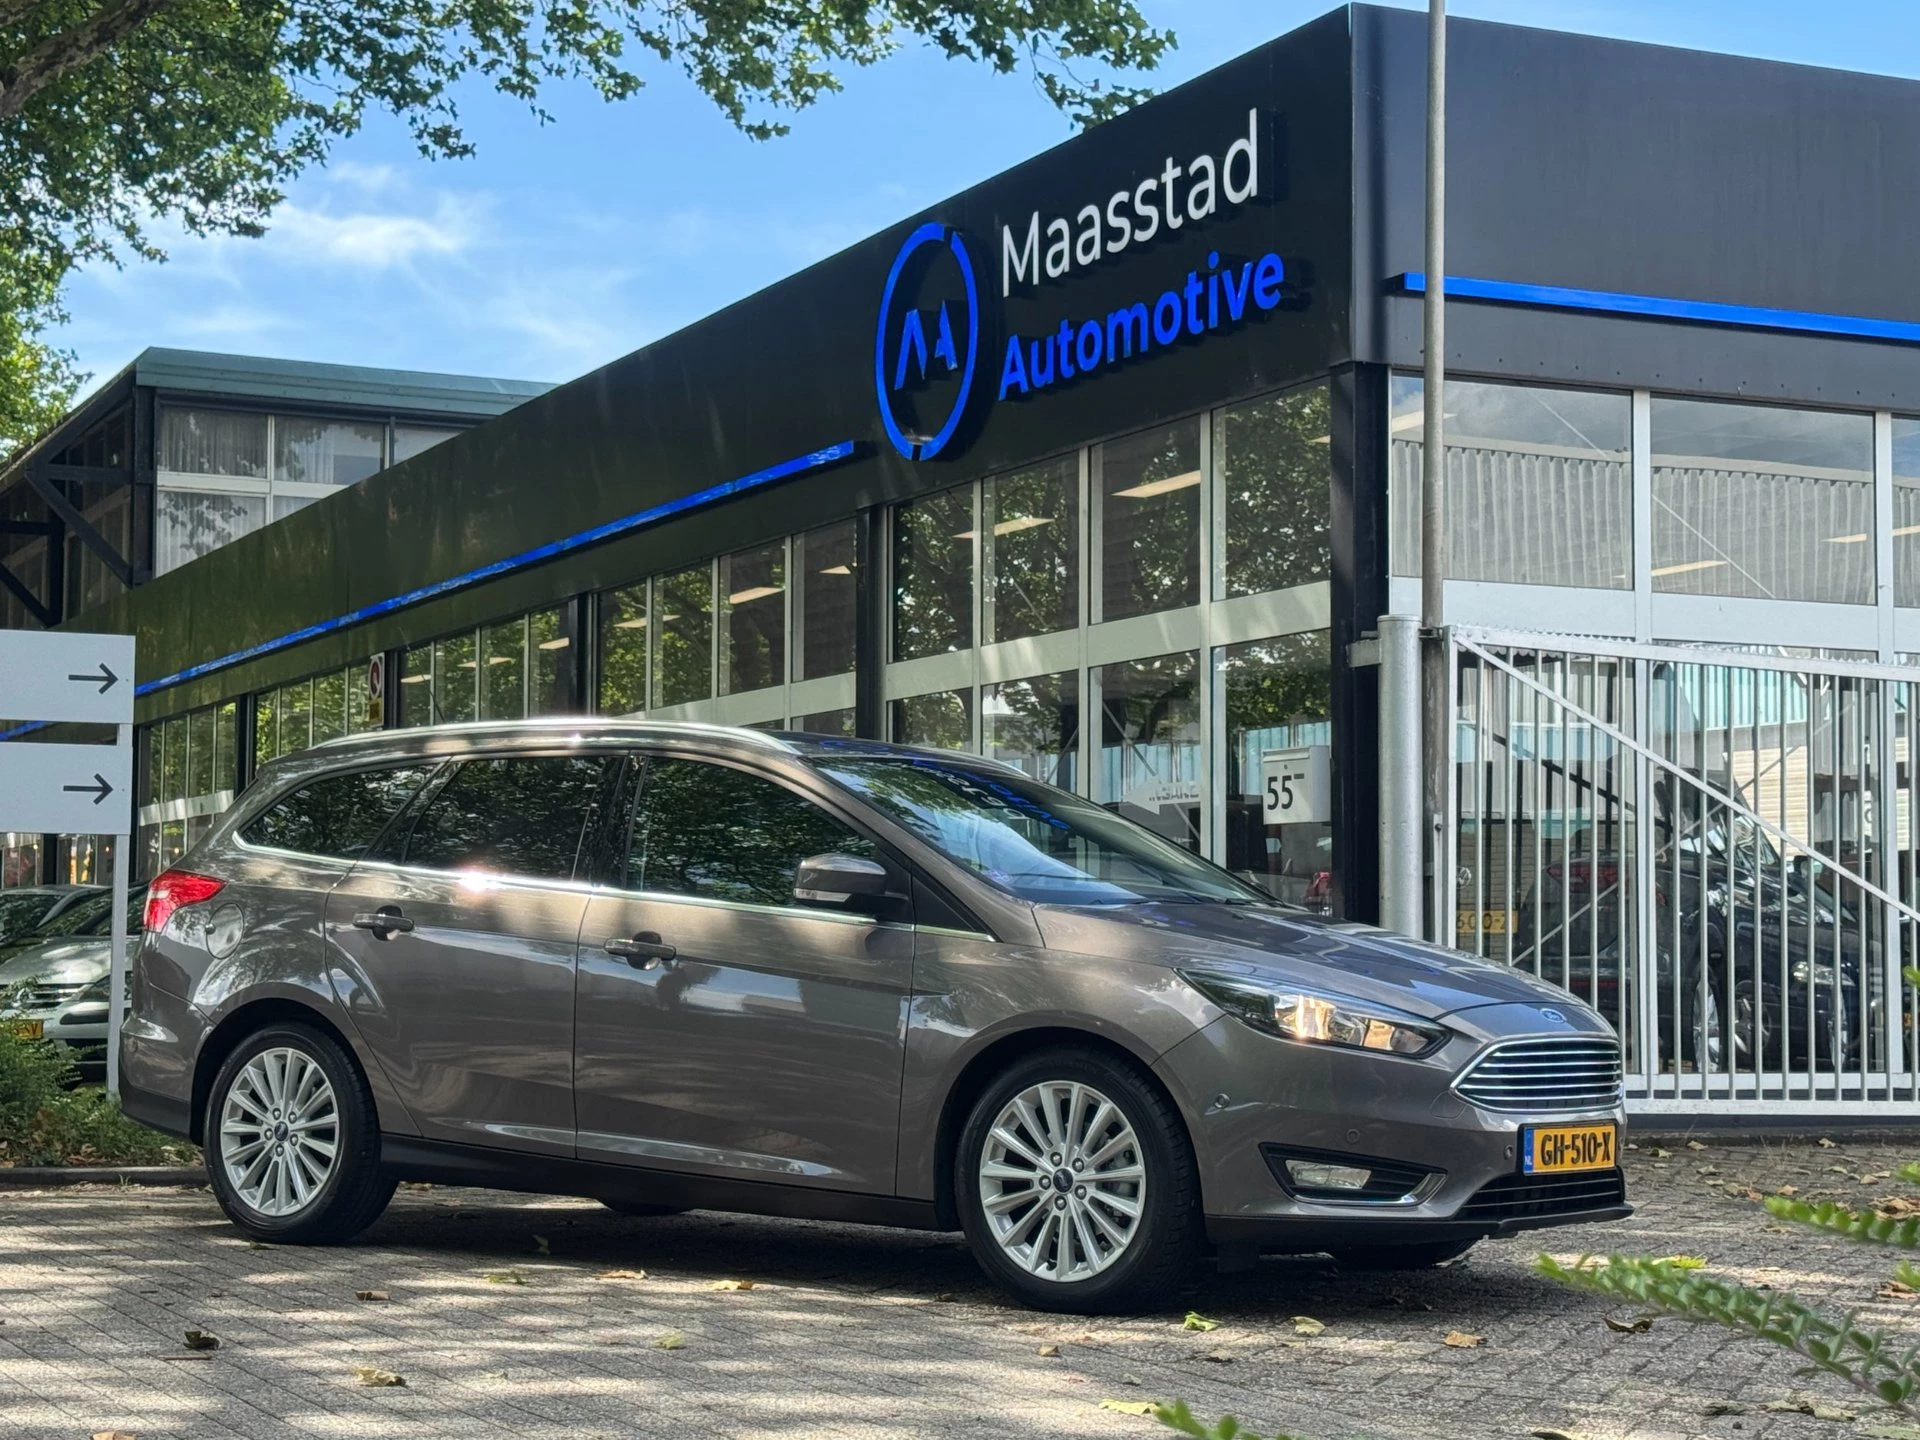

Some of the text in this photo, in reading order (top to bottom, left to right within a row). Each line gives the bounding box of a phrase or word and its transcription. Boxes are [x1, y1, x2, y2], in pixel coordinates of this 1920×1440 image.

[1002, 107, 1258, 298] Maasstad
[998, 250, 1285, 401] Automotive
[1541, 1131, 1612, 1167] GH-510-X
